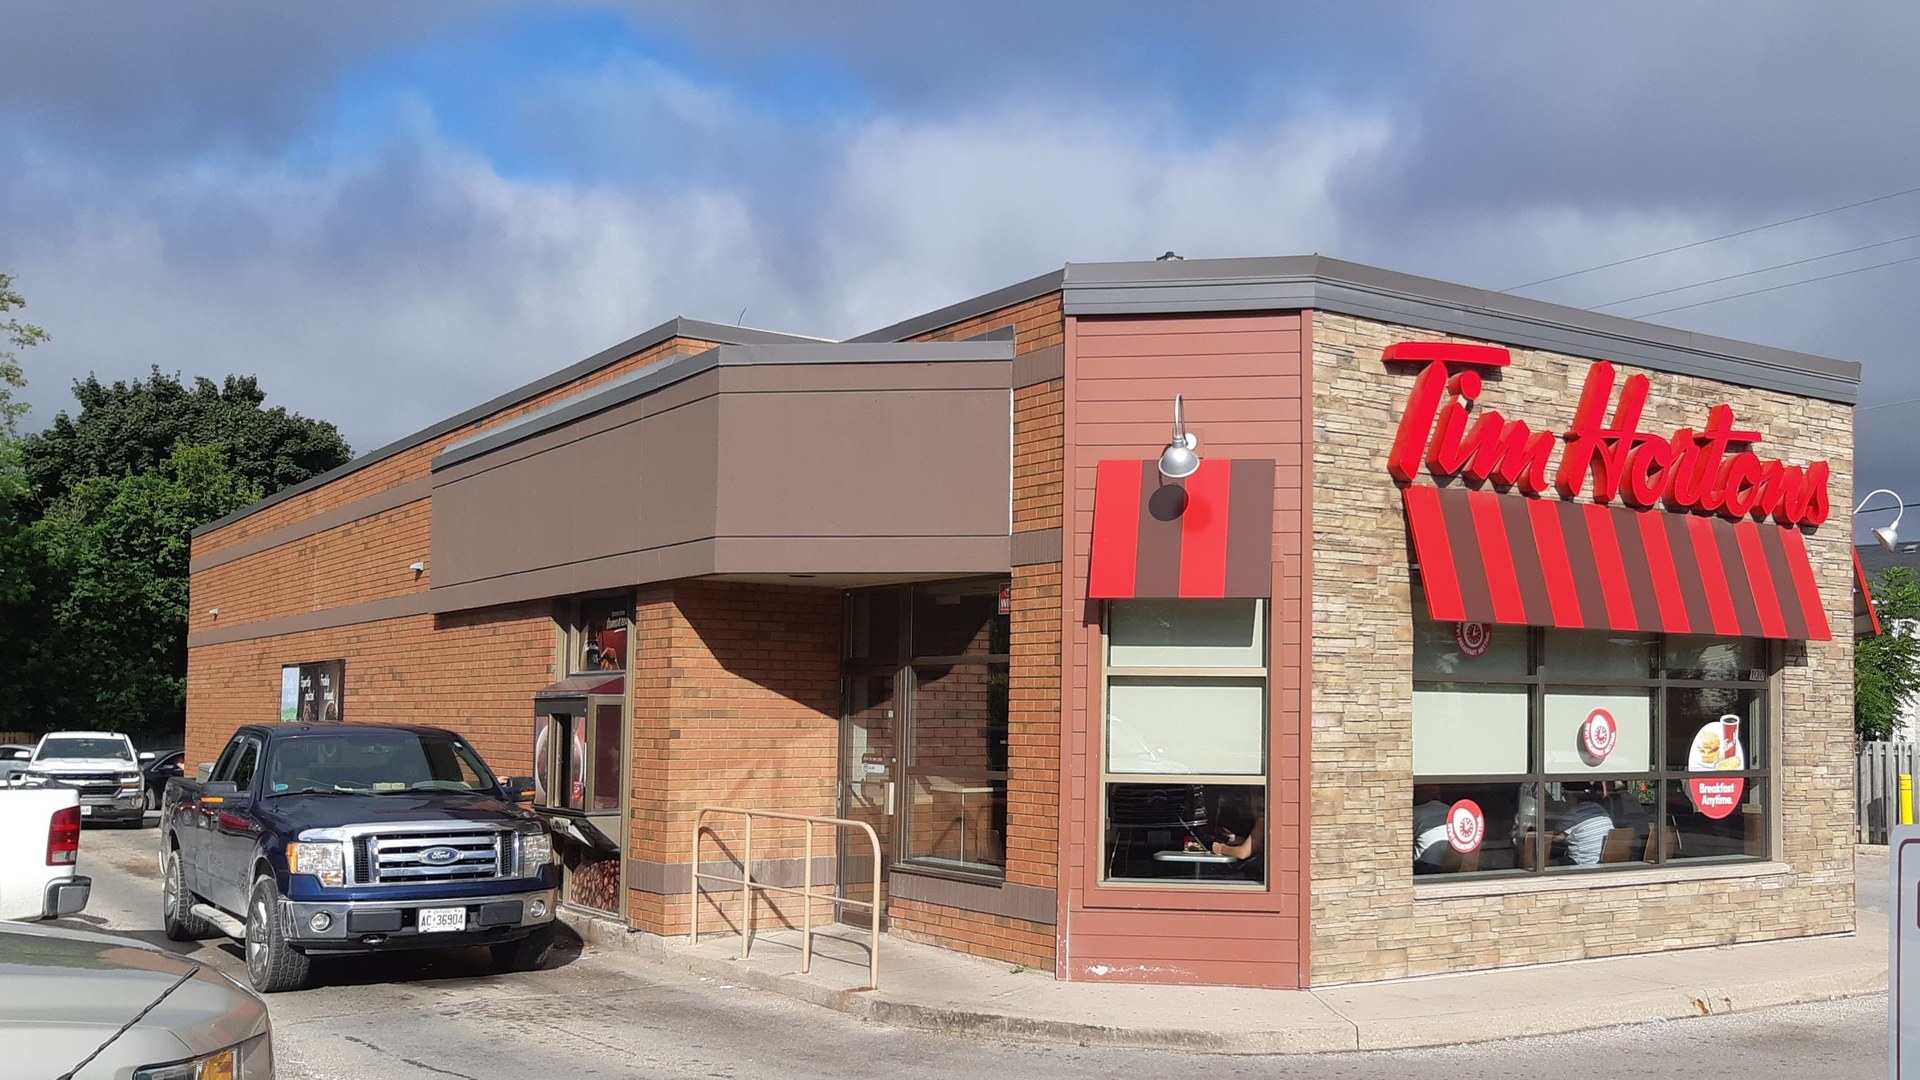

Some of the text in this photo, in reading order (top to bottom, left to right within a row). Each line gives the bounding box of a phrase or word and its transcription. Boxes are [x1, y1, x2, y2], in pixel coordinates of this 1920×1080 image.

[1381, 342, 1829, 525] Tim Hortons
[1699, 782, 1735, 793] Breakfast
[1701, 794, 1733, 808] Anytime.
[431, 851, 451, 860] Ford
[436, 913, 463, 926] 36904
